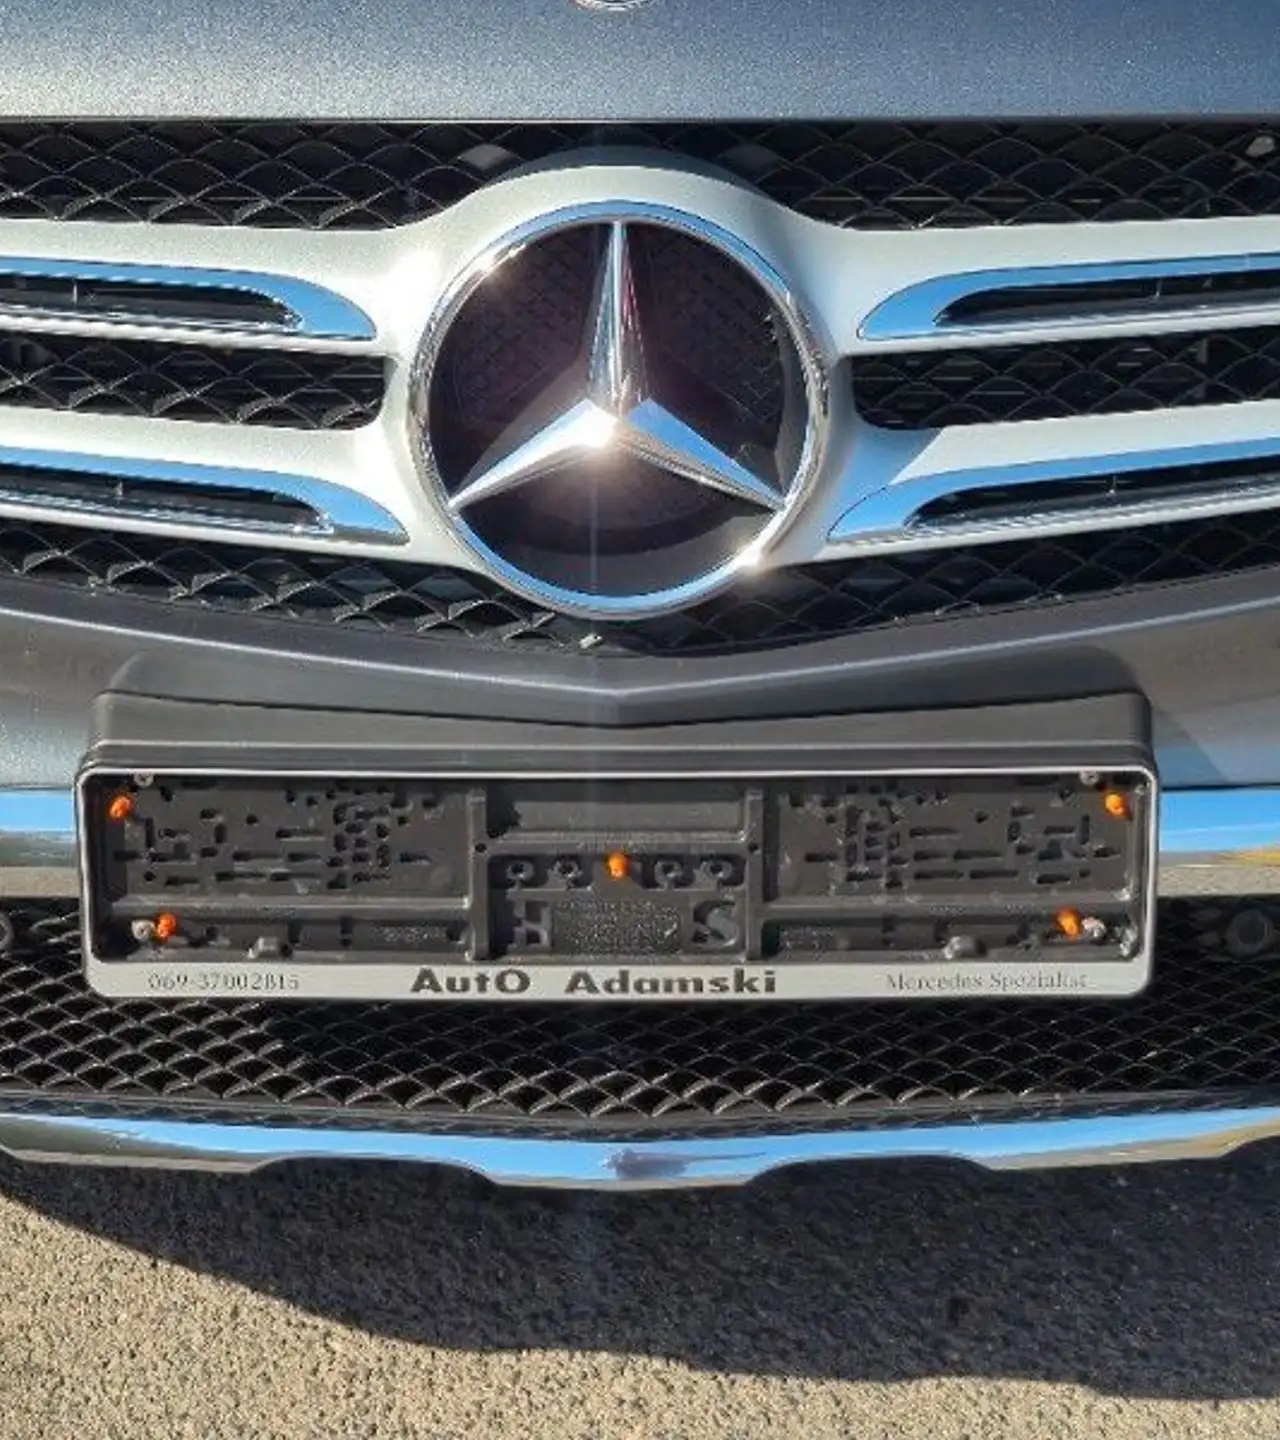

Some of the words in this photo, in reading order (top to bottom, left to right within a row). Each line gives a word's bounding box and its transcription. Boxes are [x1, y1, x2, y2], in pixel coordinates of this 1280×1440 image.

[410, 968, 531, 995] AutO
[564, 968, 777, 995] Adamski
[885, 972, 983, 991] Mercedes
